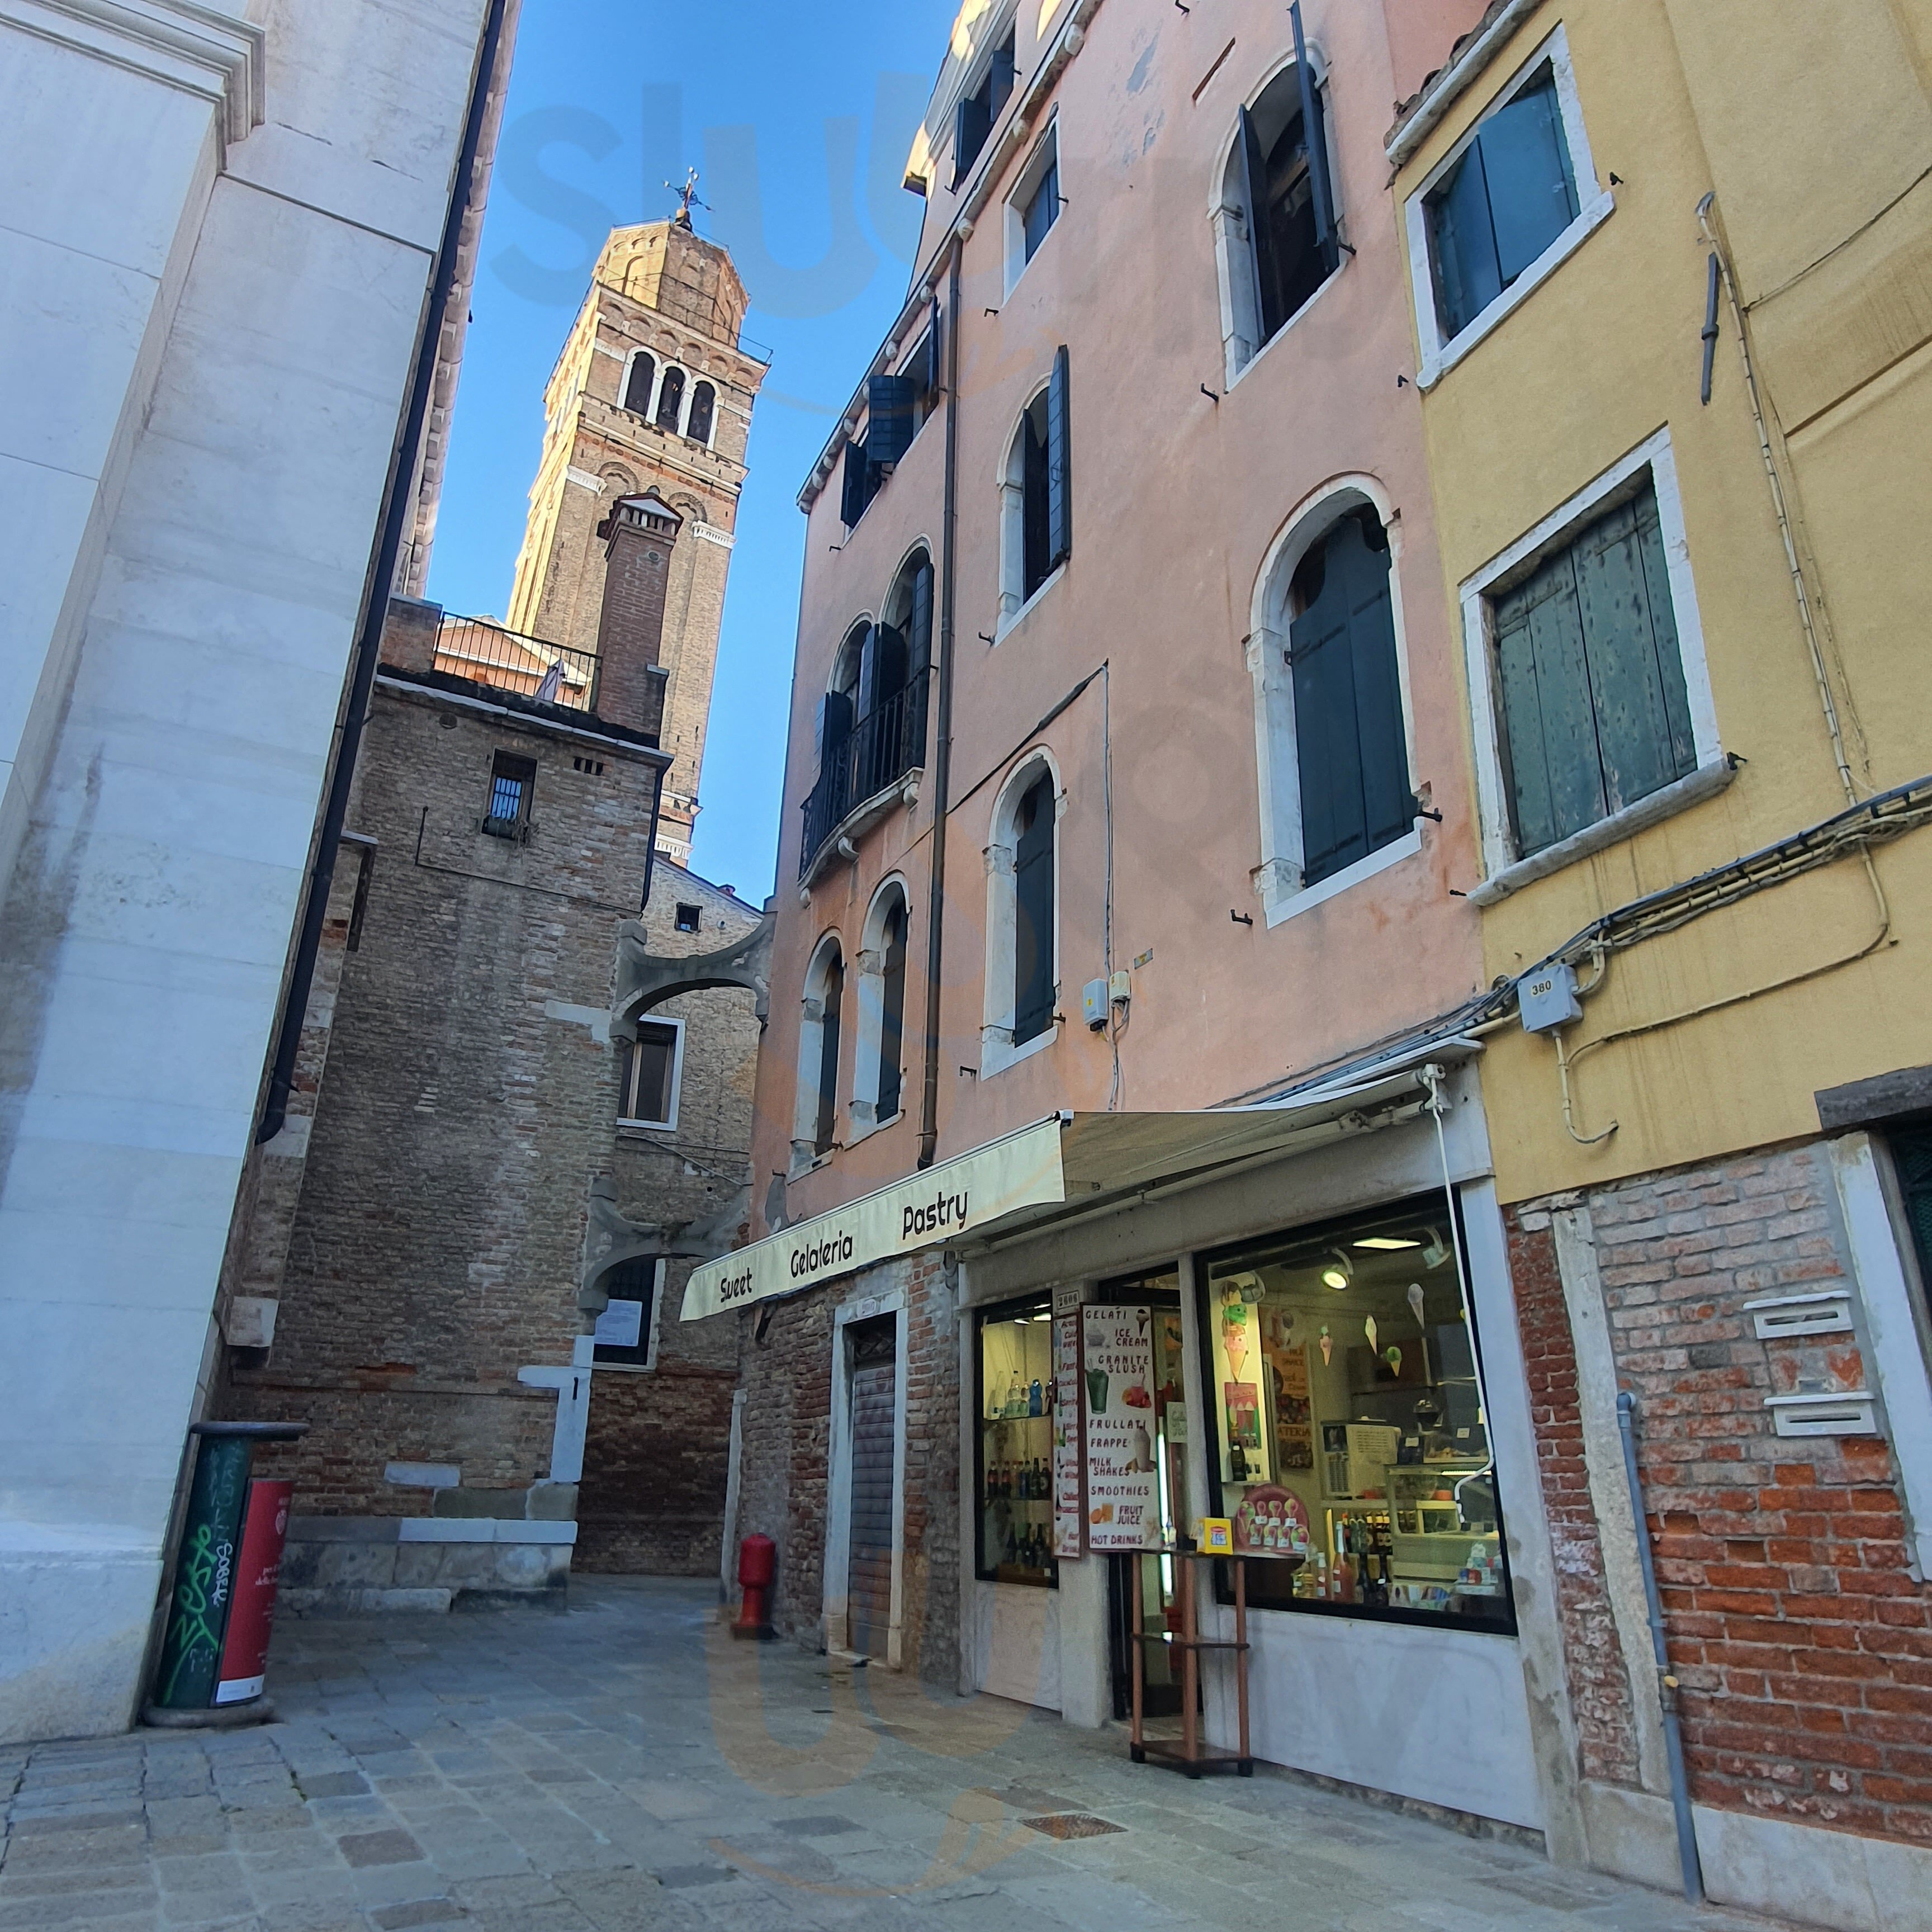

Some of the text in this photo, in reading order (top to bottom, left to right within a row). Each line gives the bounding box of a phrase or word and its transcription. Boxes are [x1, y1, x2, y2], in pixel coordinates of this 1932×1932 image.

[1532, 980, 1551, 995] 380
[720, 1191, 968, 1303] Sweet Gelateria Pastry
[1086, 1310, 1126, 1319] GELATI
[1115, 1328, 1130, 1337] ICE
[1116, 1338, 1148, 1346] CREAM
[1098, 1355, 1149, 1365] GRANITE
[1109, 1365, 1145, 1374] SLUSH
[1089, 1419, 1146, 1429] FRULLATI
[1091, 1438, 1128, 1447] FRAPPE
[1090, 1457, 1111, 1466] MILK
[1093, 1467, 1130, 1476] SHAKES
[1091, 1486, 1149, 1495] SMOOTHIES
[1119, 1505, 1144, 1514] FRUIT
[1117, 1516, 1140, 1524] JUICE
[1091, 1535, 1143, 1545] HOT DRINKS
